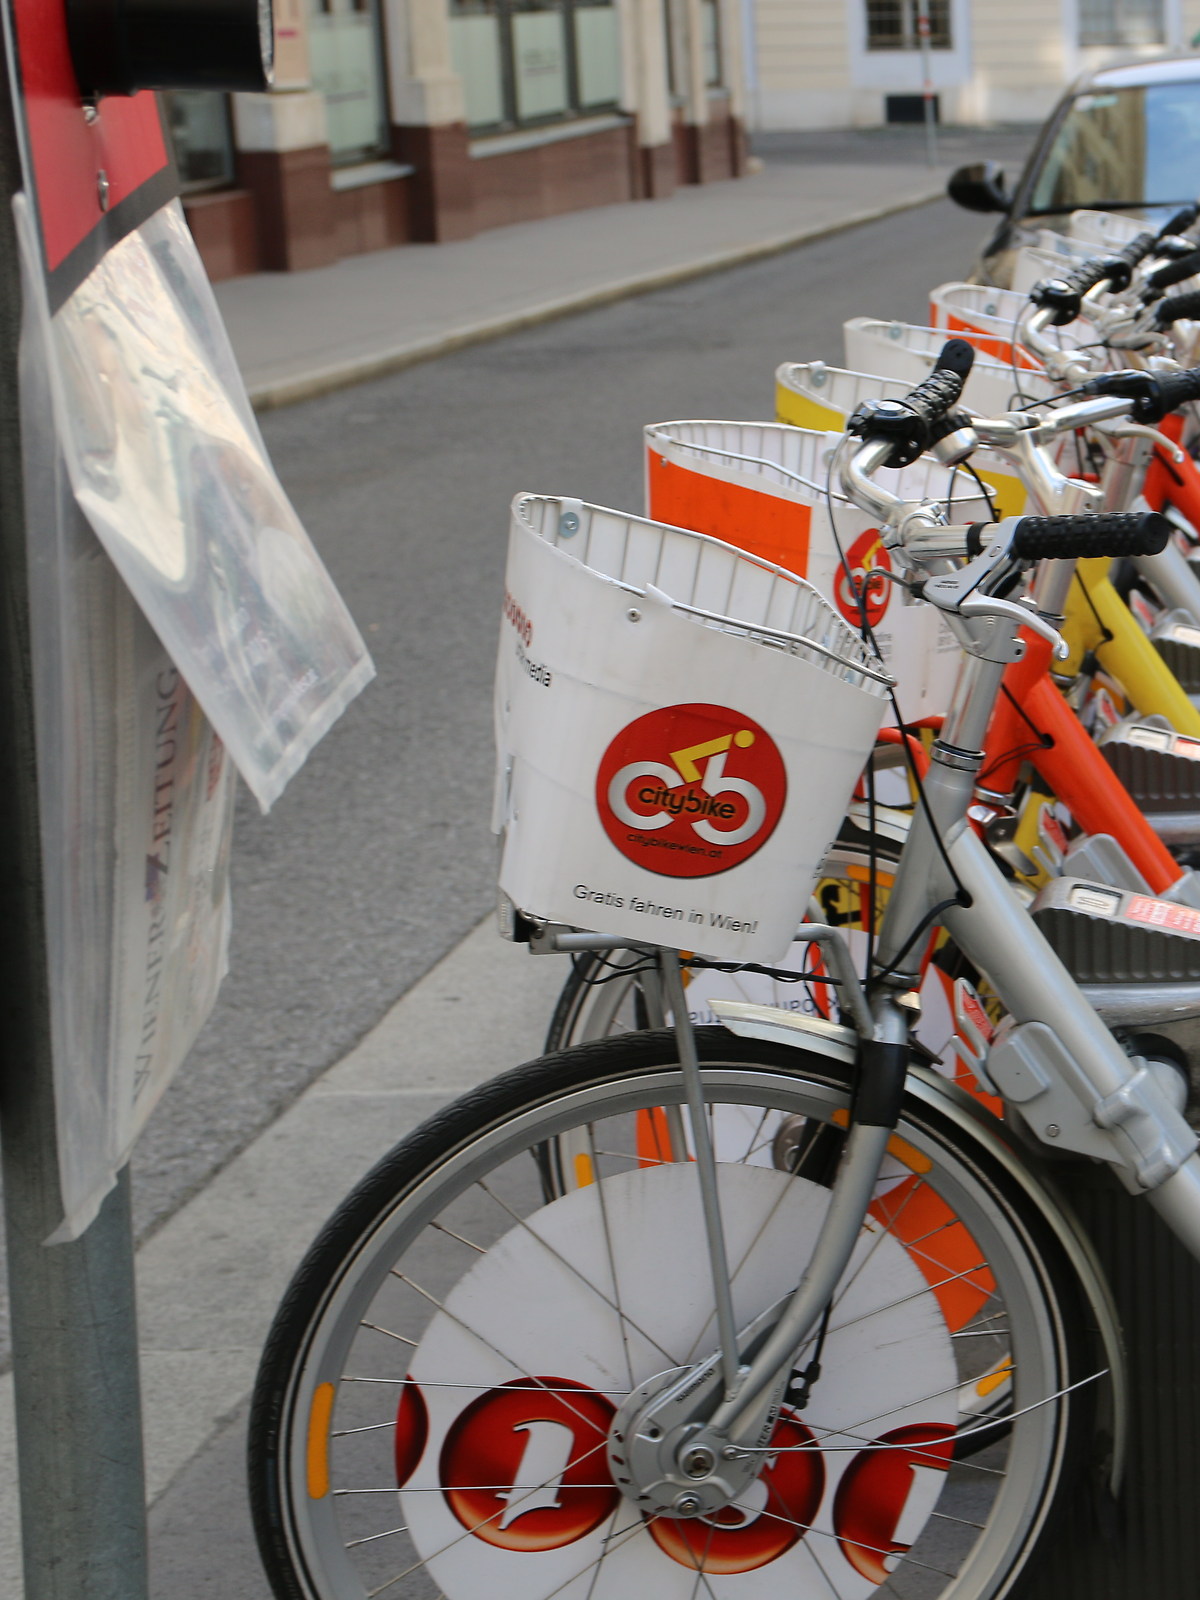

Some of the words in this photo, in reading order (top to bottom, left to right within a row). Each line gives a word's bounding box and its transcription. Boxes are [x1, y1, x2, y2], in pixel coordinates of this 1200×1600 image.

[638, 787, 736, 819] citybike
[572, 884, 624, 909] Gratis
[628, 896, 684, 921] fahren
[688, 908, 704, 925] in
[709, 912, 760, 935] Wien!
